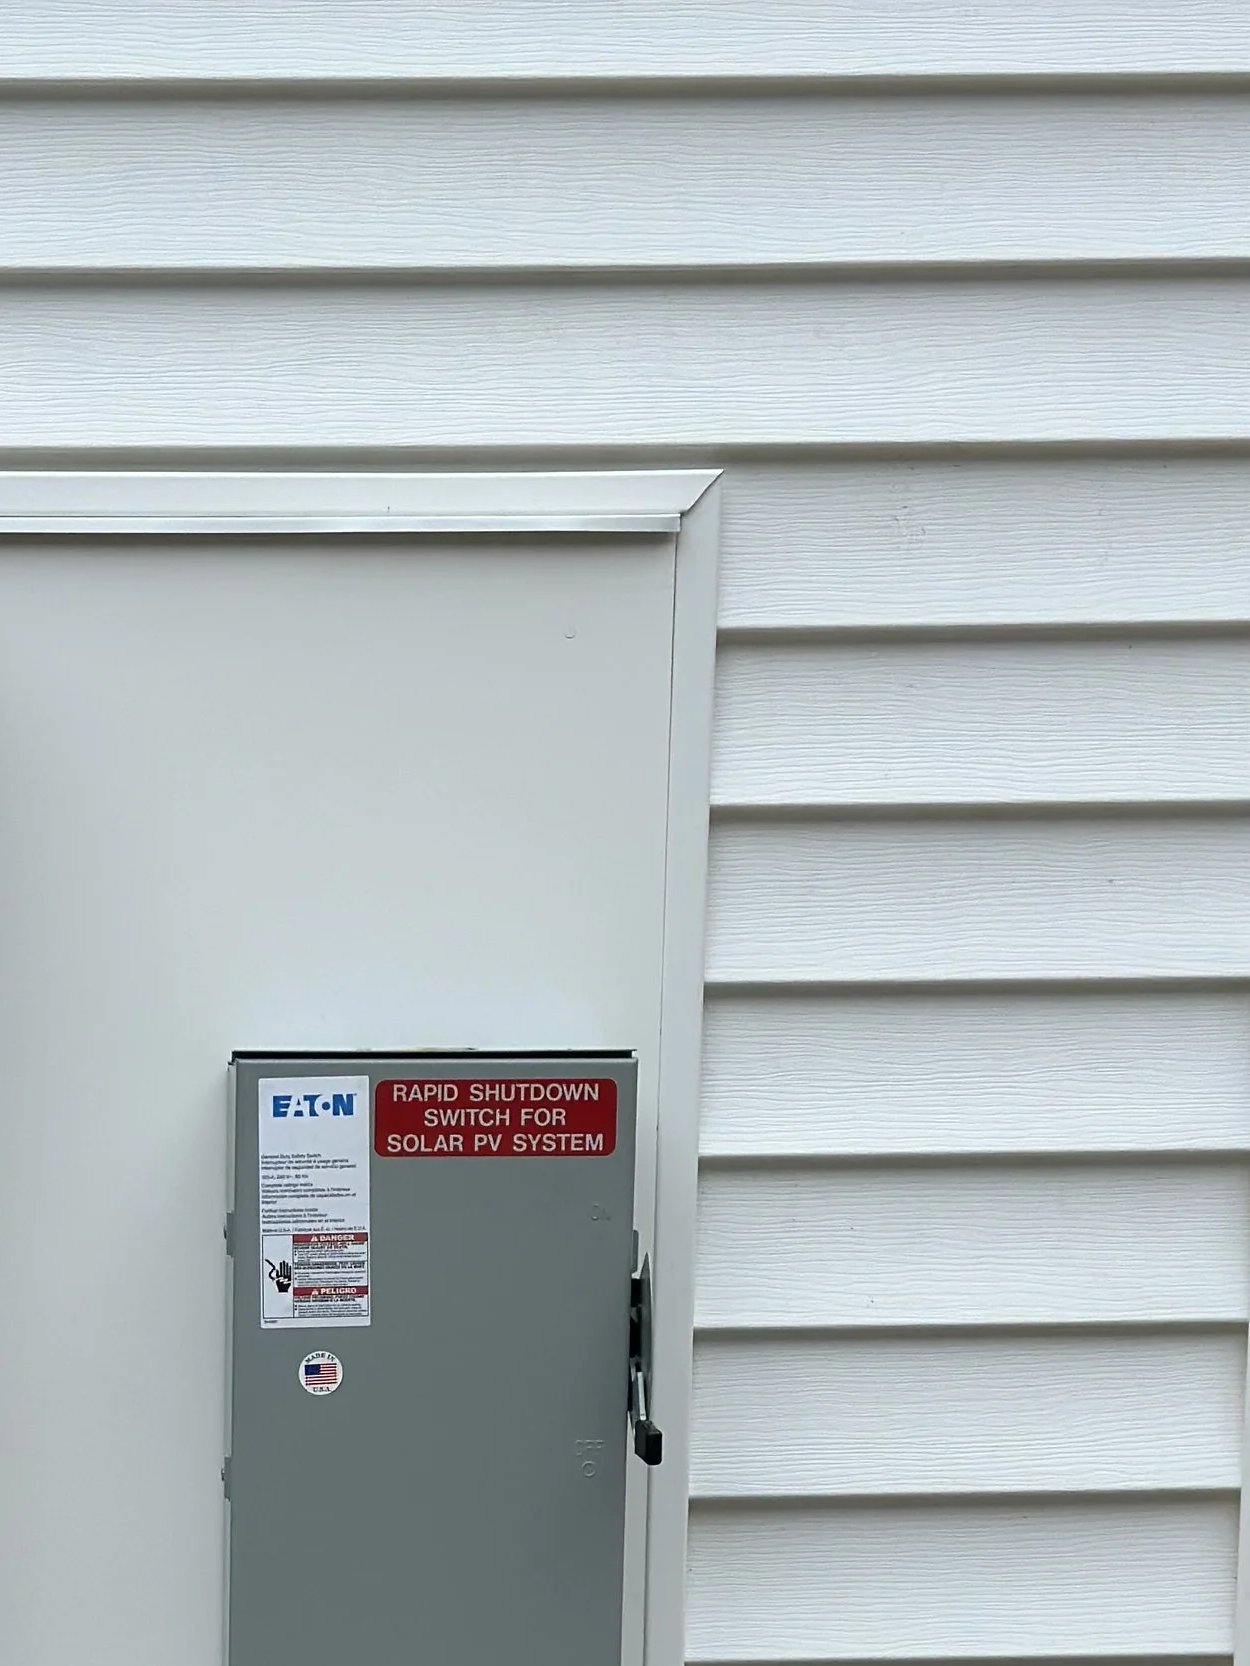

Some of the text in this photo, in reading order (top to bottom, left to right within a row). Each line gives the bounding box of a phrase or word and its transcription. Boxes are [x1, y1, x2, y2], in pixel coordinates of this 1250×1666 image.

[393, 1083, 599, 1102] RAPID SHUTDOWN
[272, 1093, 354, 1118] EATON
[424, 1108, 566, 1126] SWITCH FOR
[387, 1133, 603, 1152] SOLAR PV SYSTEM
[305, 1353, 326, 1363] MADE
